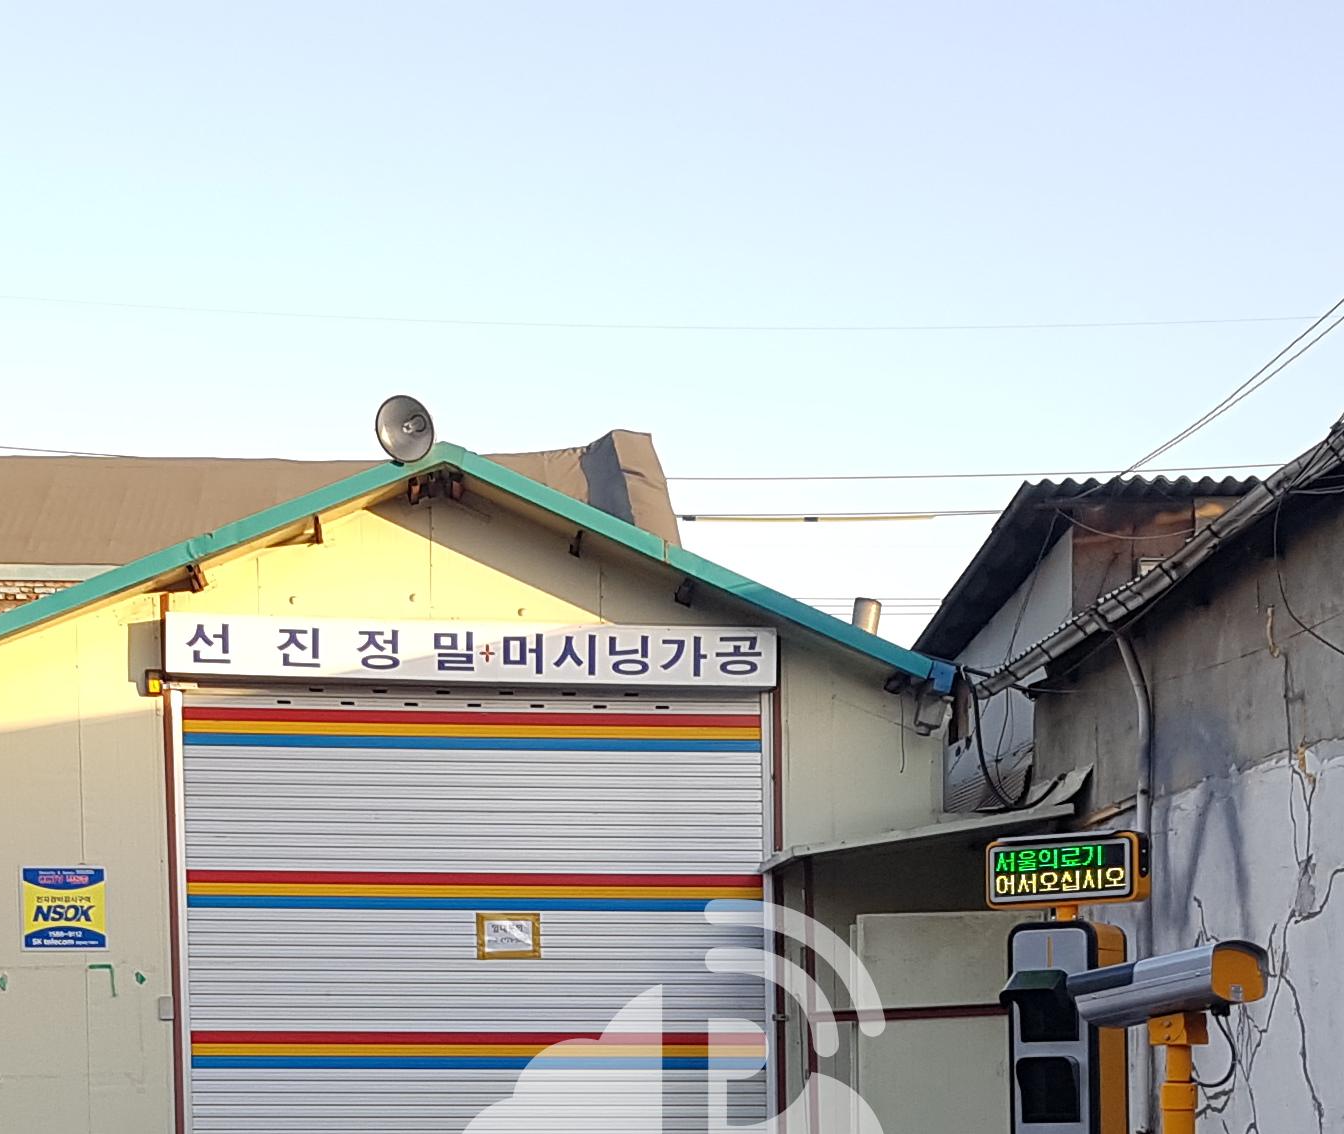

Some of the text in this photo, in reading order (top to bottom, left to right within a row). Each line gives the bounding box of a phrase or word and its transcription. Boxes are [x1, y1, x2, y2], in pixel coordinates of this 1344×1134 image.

[995, 845, 1103, 873] 서울의료기
[995, 867, 1127, 895] 어서오십시오
[32, 904, 96, 922] NSOK
